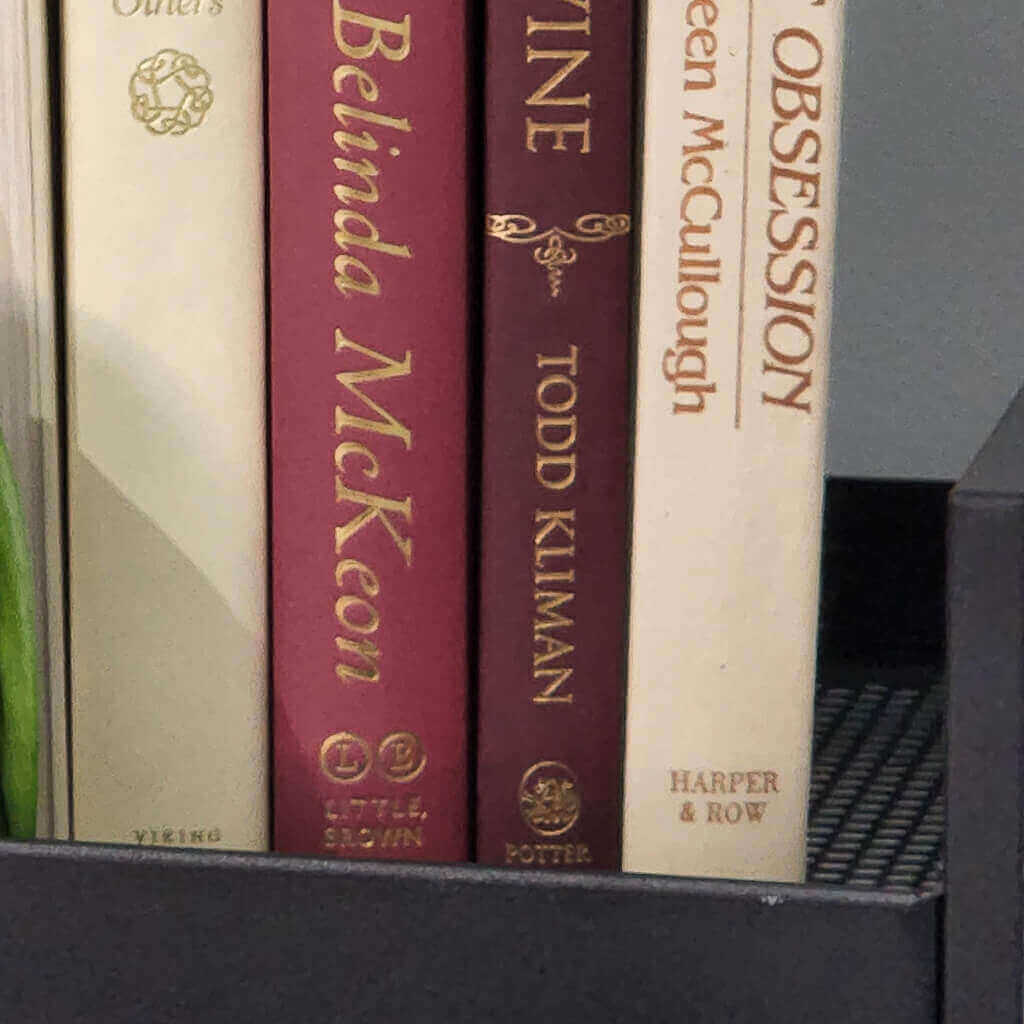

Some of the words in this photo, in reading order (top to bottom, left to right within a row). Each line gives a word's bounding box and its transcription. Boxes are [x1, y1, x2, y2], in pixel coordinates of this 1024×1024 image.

[662, 110, 725, 415] McCullough
[761, 27, 823, 413] OBSESSION
[536, 345, 578, 490] TODD
[334, 327, 412, 683] McKeon
[532, 508, 575, 704] KLIMAN
[505, 842, 592, 864] POTTER
[669, 769, 780, 794] HARPER
[679, 800, 695, 822] &
[706, 800, 767, 824] ROW
